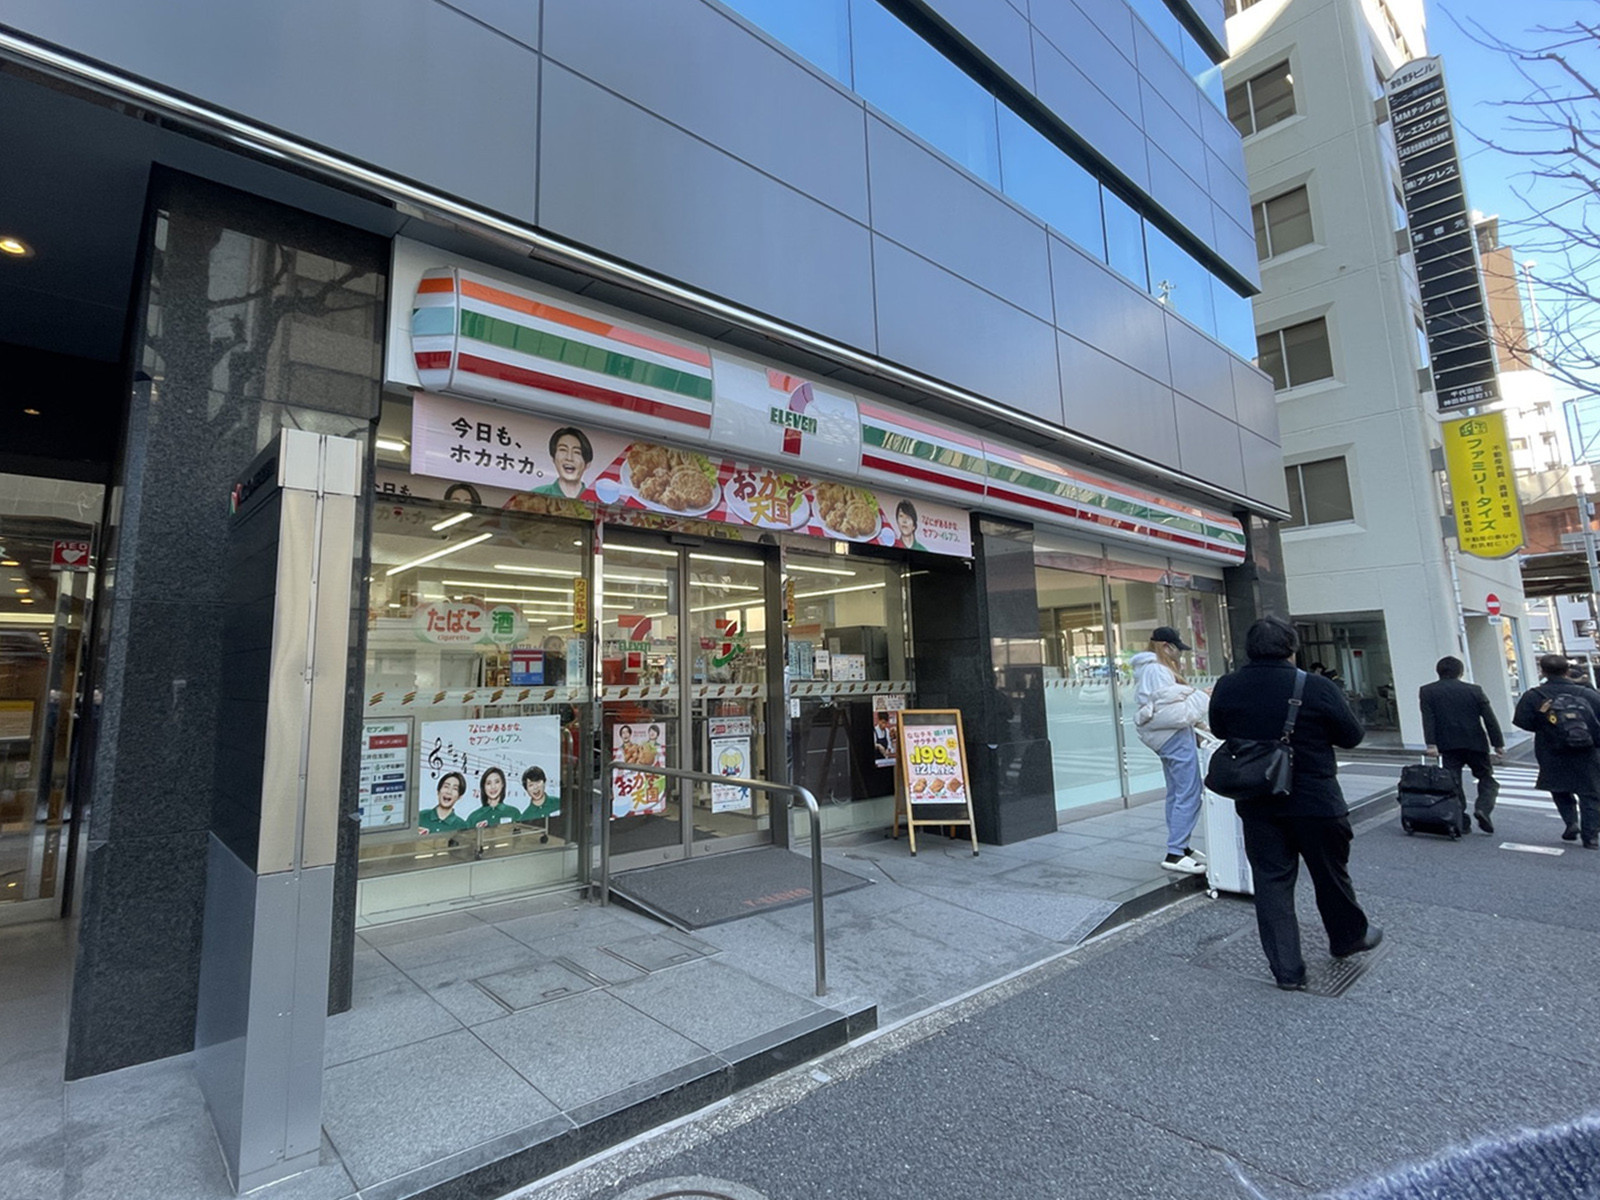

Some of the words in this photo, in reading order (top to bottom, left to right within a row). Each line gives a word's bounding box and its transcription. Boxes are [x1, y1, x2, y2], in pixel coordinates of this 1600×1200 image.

[451, 416, 524, 449] 今日も、
[450, 444, 545, 479] ホカホカ。
[1467, 437, 1497, 532] ファミリータイズ
[749, 495, 792, 526] 天国
[57, 541, 88, 550] AED
[427, 608, 481, 632] たばこ
[492, 611, 514, 634] 酒
